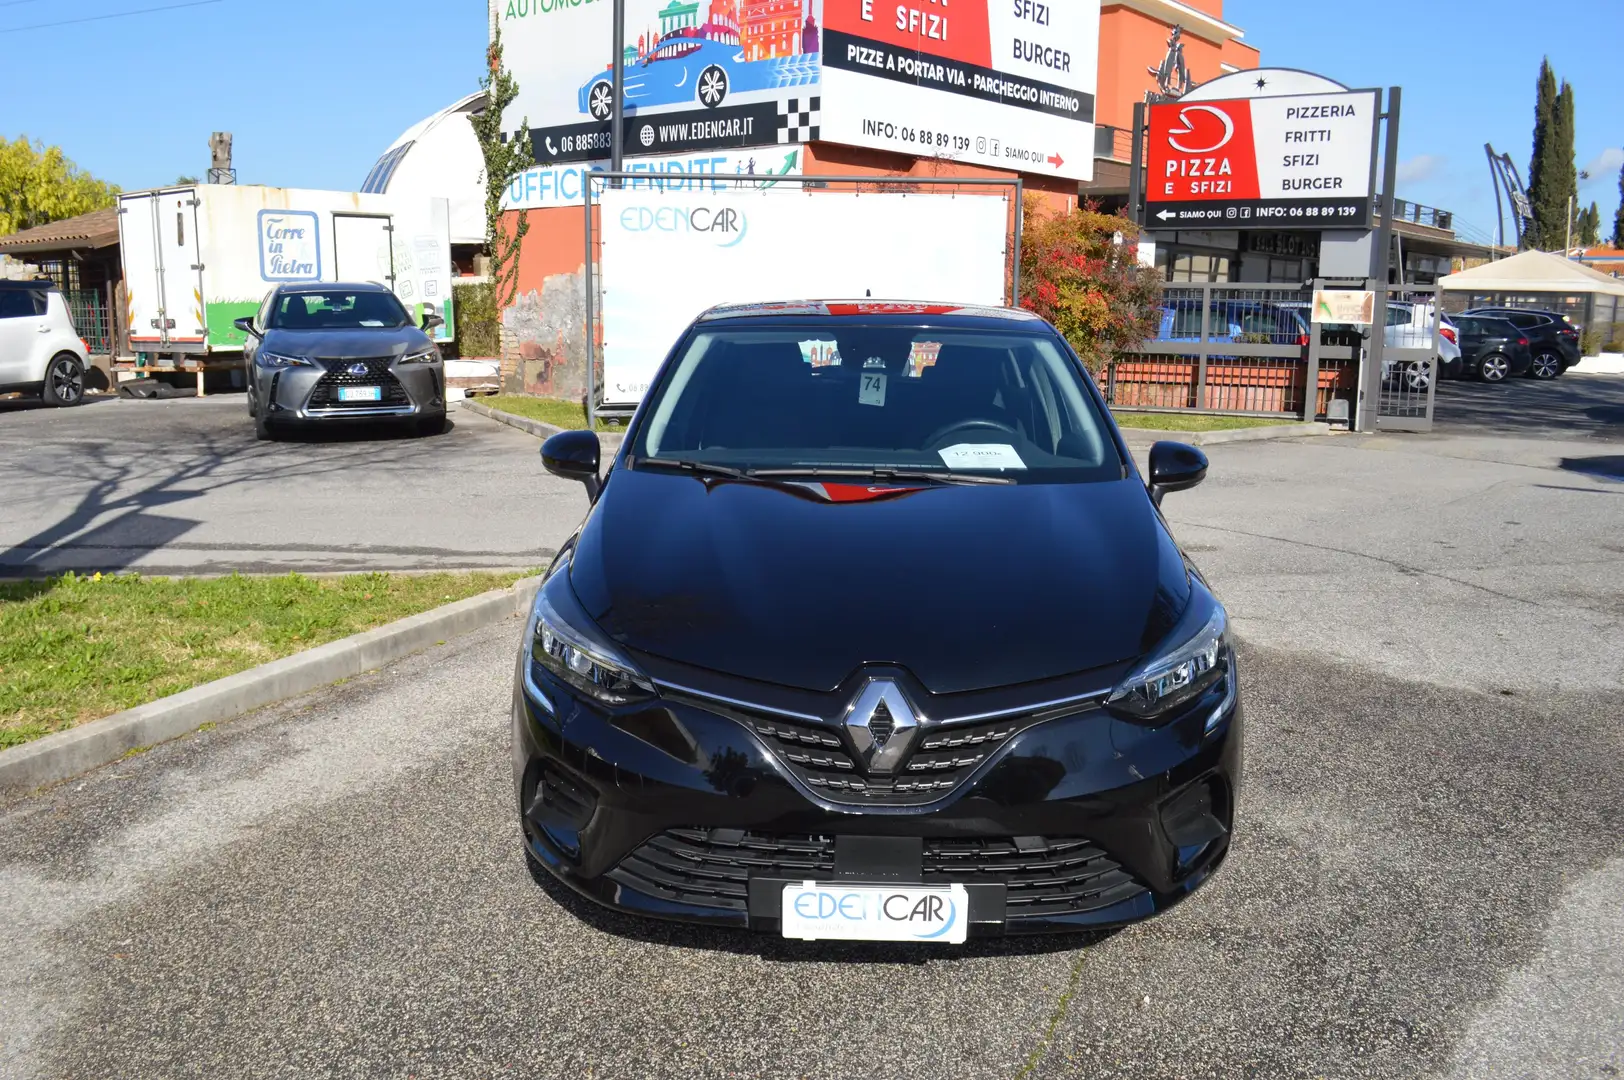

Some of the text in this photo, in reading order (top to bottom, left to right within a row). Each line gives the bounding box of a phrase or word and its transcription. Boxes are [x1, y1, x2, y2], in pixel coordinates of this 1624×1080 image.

[862, 0, 948, 41] E SFIZI
[1013, 0, 1050, 27] SFIZI
[1013, 37, 1071, 73] BURGER
[847, 43, 1080, 113] PIZZE A PORTAR VIA PARCHEGGIO INTERNO
[1286, 104, 1356, 120] PIZZERIA
[659, 117, 754, 143] WWW.EDENCAR.IT
[862, 118, 970, 152] INFO: 06 88 89 139
[1285, 129, 1331, 143] FRITTI
[561, 135, 573, 152] 06
[1005, 146, 1045, 165] SIAMO QUI
[1283, 153, 1319, 167] SFIZI
[1165, 157, 1232, 177] PIZZA
[1165, 180, 1232, 195] E SFIZI
[1282, 177, 1343, 191] BURGER
[619, 206, 740, 233] EDENCAR
[1179, 206, 1356, 219] SIAMO QUI INFO: 06 88 89 139
[266, 218, 305, 240] Torre
[268, 240, 283, 254] in
[270, 254, 313, 274] Pietra
[864, 376, 881, 392] 74
